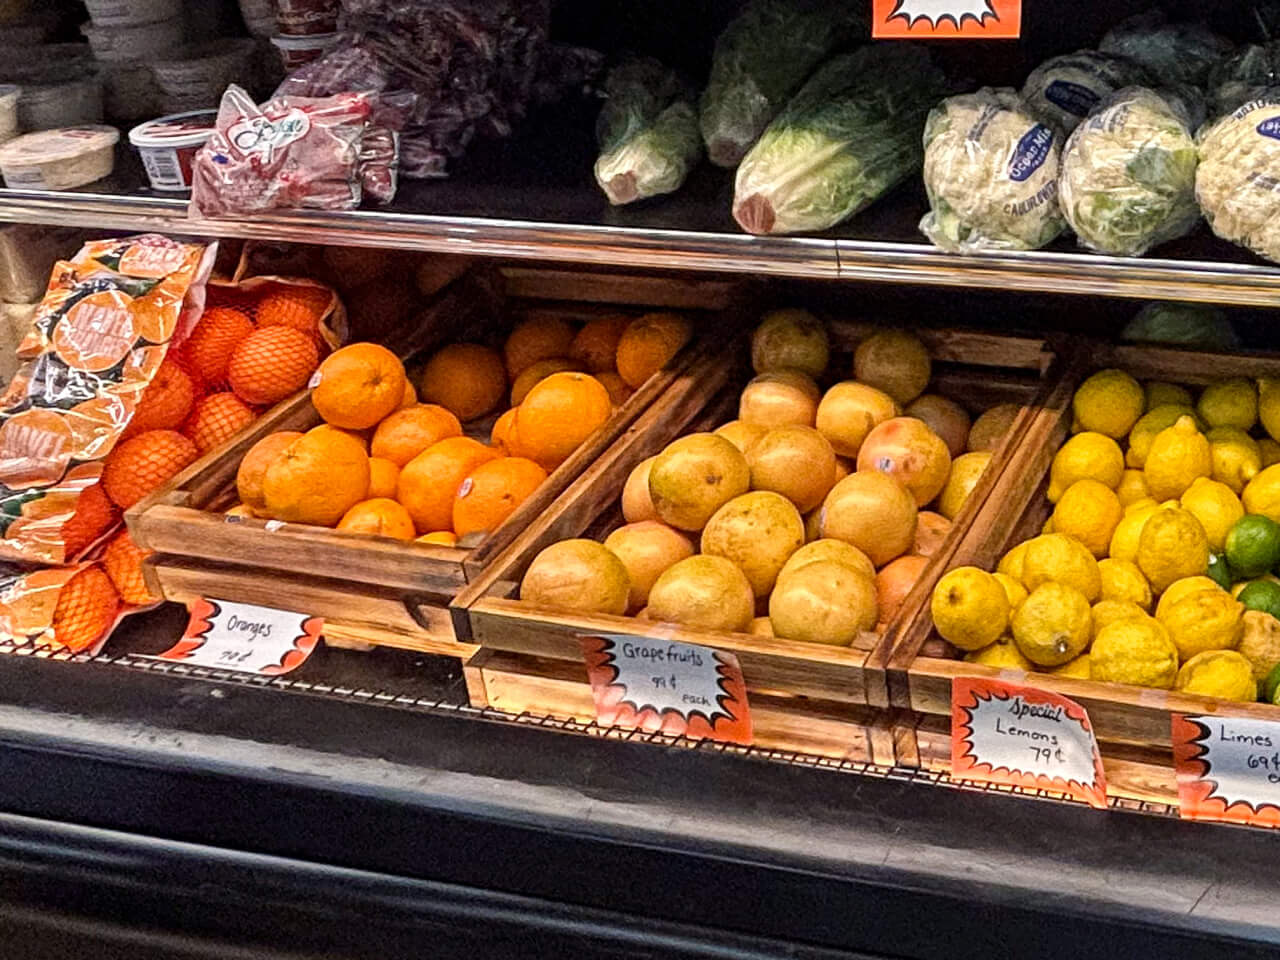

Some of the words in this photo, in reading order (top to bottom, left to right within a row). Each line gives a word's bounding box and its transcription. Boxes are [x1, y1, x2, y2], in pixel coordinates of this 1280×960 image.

[1032, 127, 1053, 147] Mis
[227, 615, 273, 642] Oranges
[622, 642, 704, 667] Grapefruits
[683, 694, 712, 707] each
[995, 718, 1059, 745] Lemons
[1220, 724, 1274, 747] Limes
[1247, 752, 1280, 771] 69¢
